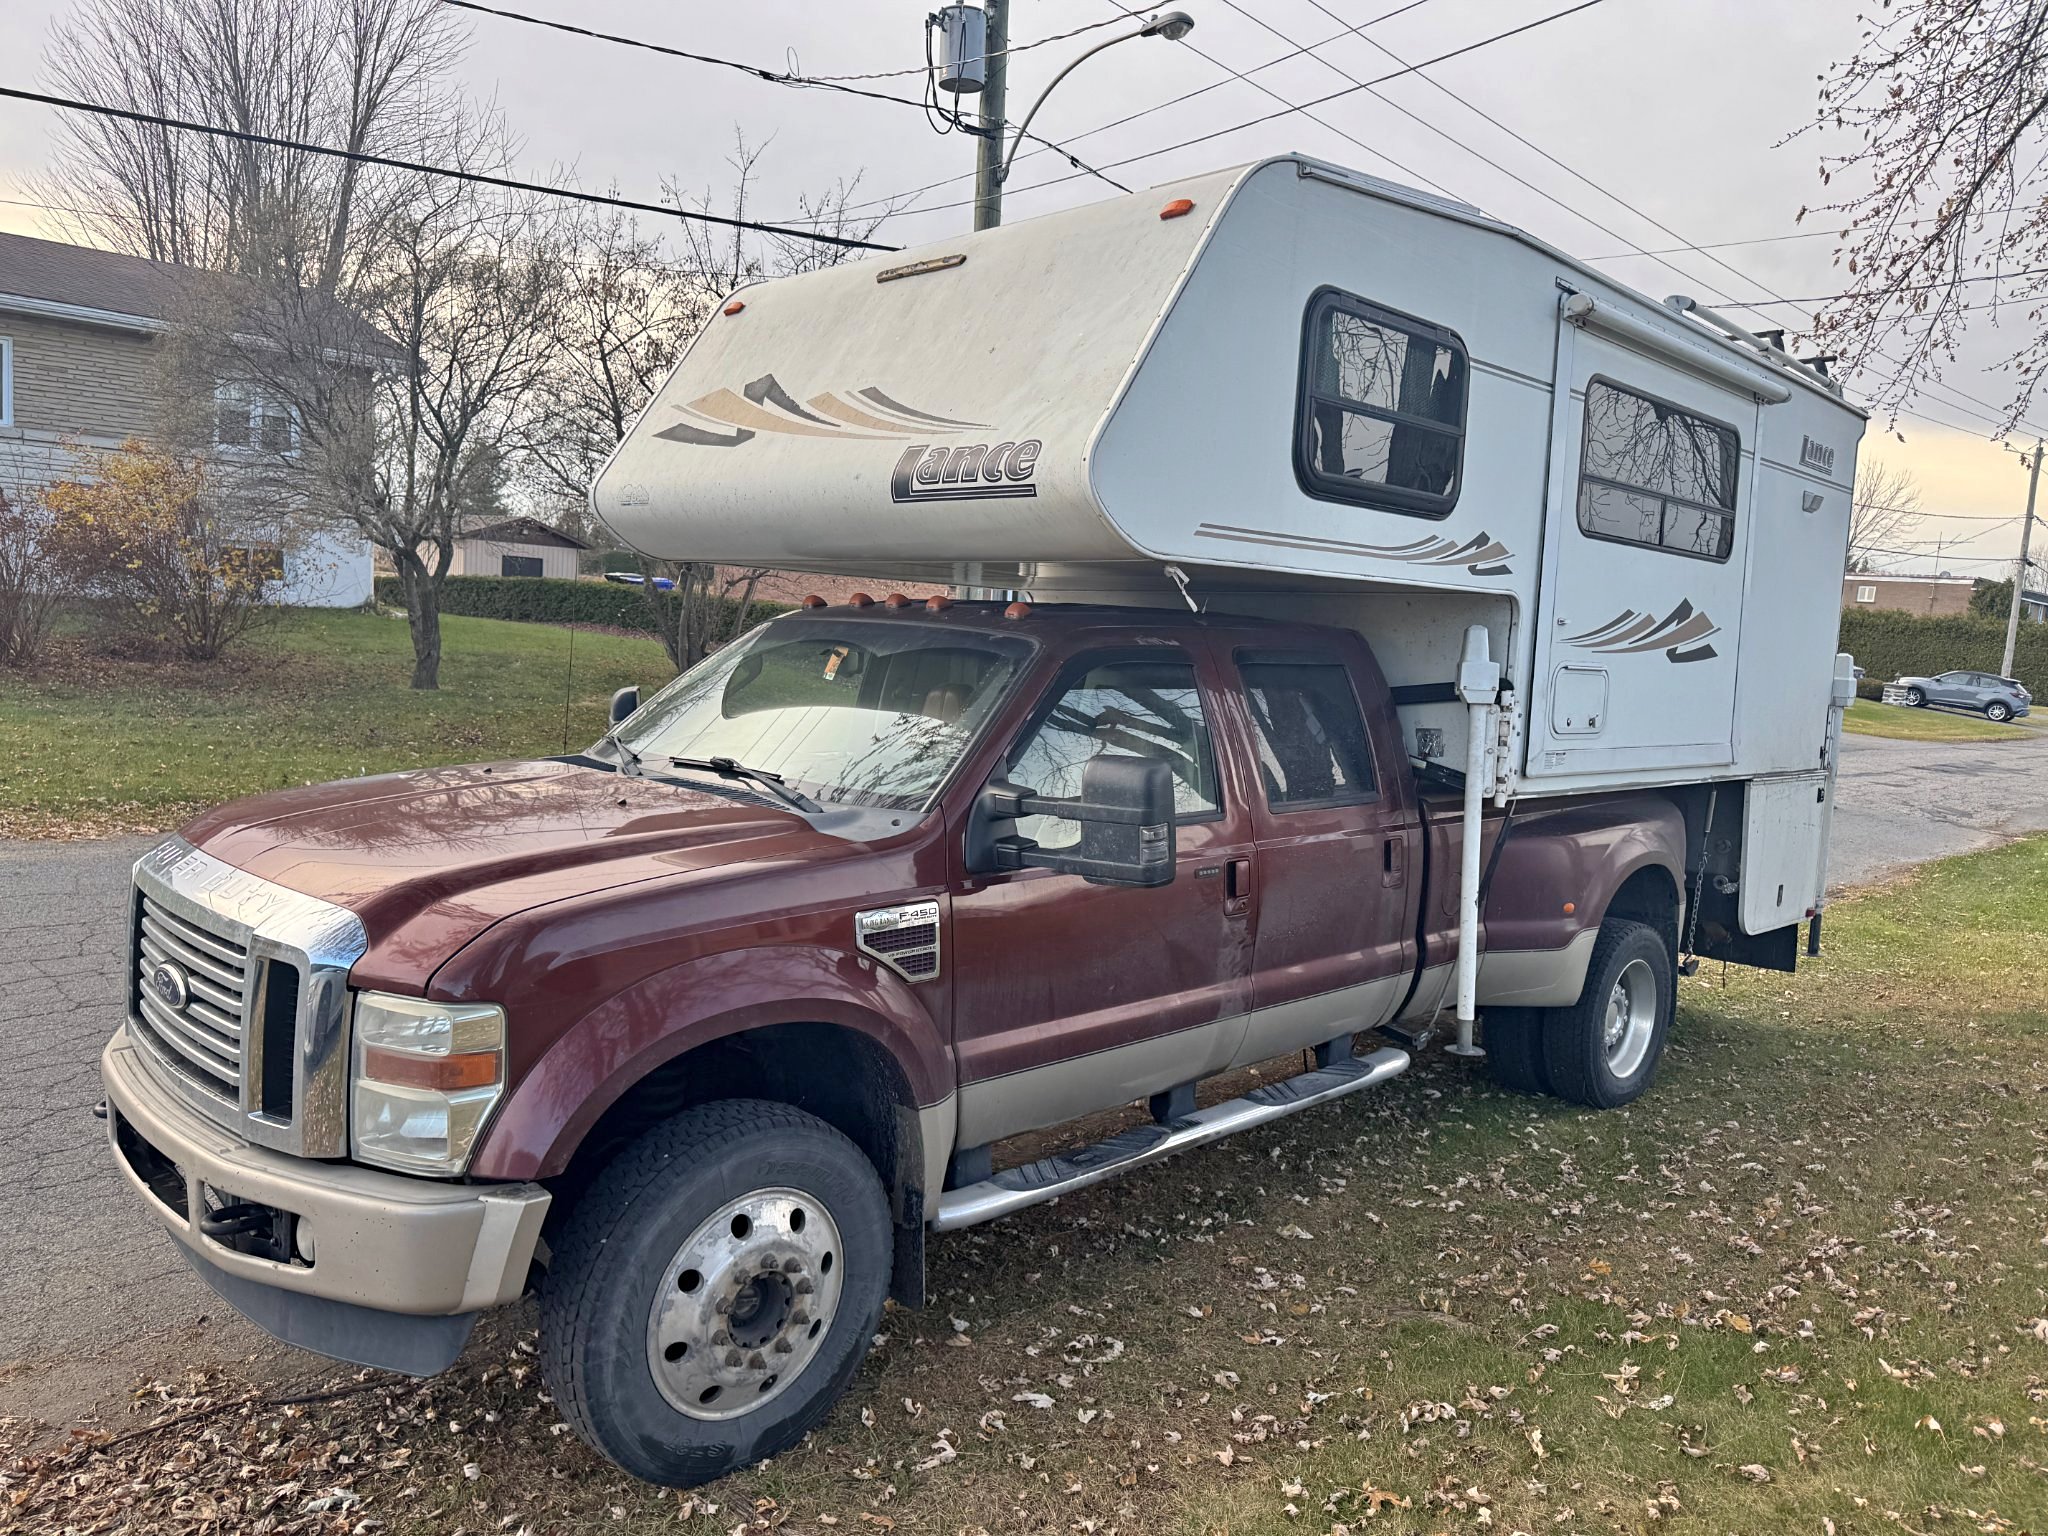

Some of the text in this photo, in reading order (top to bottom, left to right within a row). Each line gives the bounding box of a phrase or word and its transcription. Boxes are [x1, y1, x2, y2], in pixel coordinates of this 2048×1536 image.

[891, 439, 1043, 503] Lance
[1799, 434, 1835, 476] Lance
[900, 907, 937, 920] F-450
[155, 971, 173, 1001] Ford
